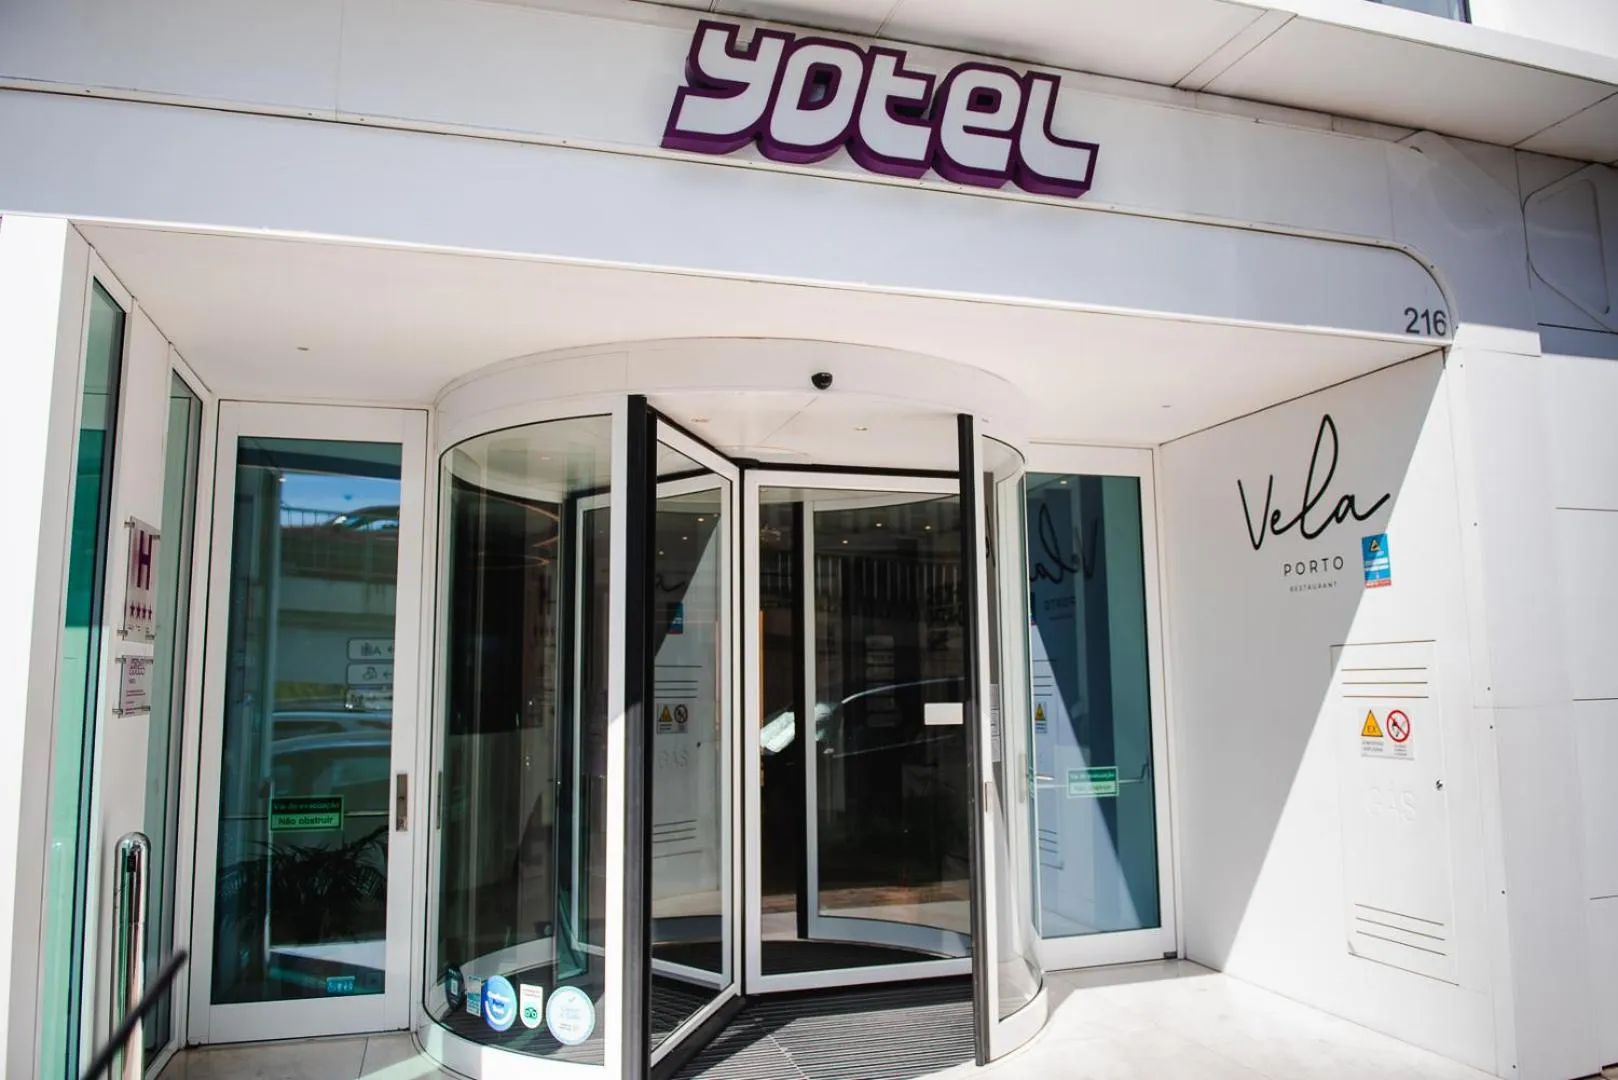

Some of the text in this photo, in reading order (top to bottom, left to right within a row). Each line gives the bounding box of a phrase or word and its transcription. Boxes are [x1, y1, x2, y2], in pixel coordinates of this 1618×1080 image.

[1404, 306, 1447, 337] 216
[1237, 414, 1391, 551] Vela
[137, 530, 153, 590] H
[1283, 555, 1344, 577] PORTO
[1289, 580, 1337, 592] RESTAURANT
[278, 814, 334, 826] Não obstruir
